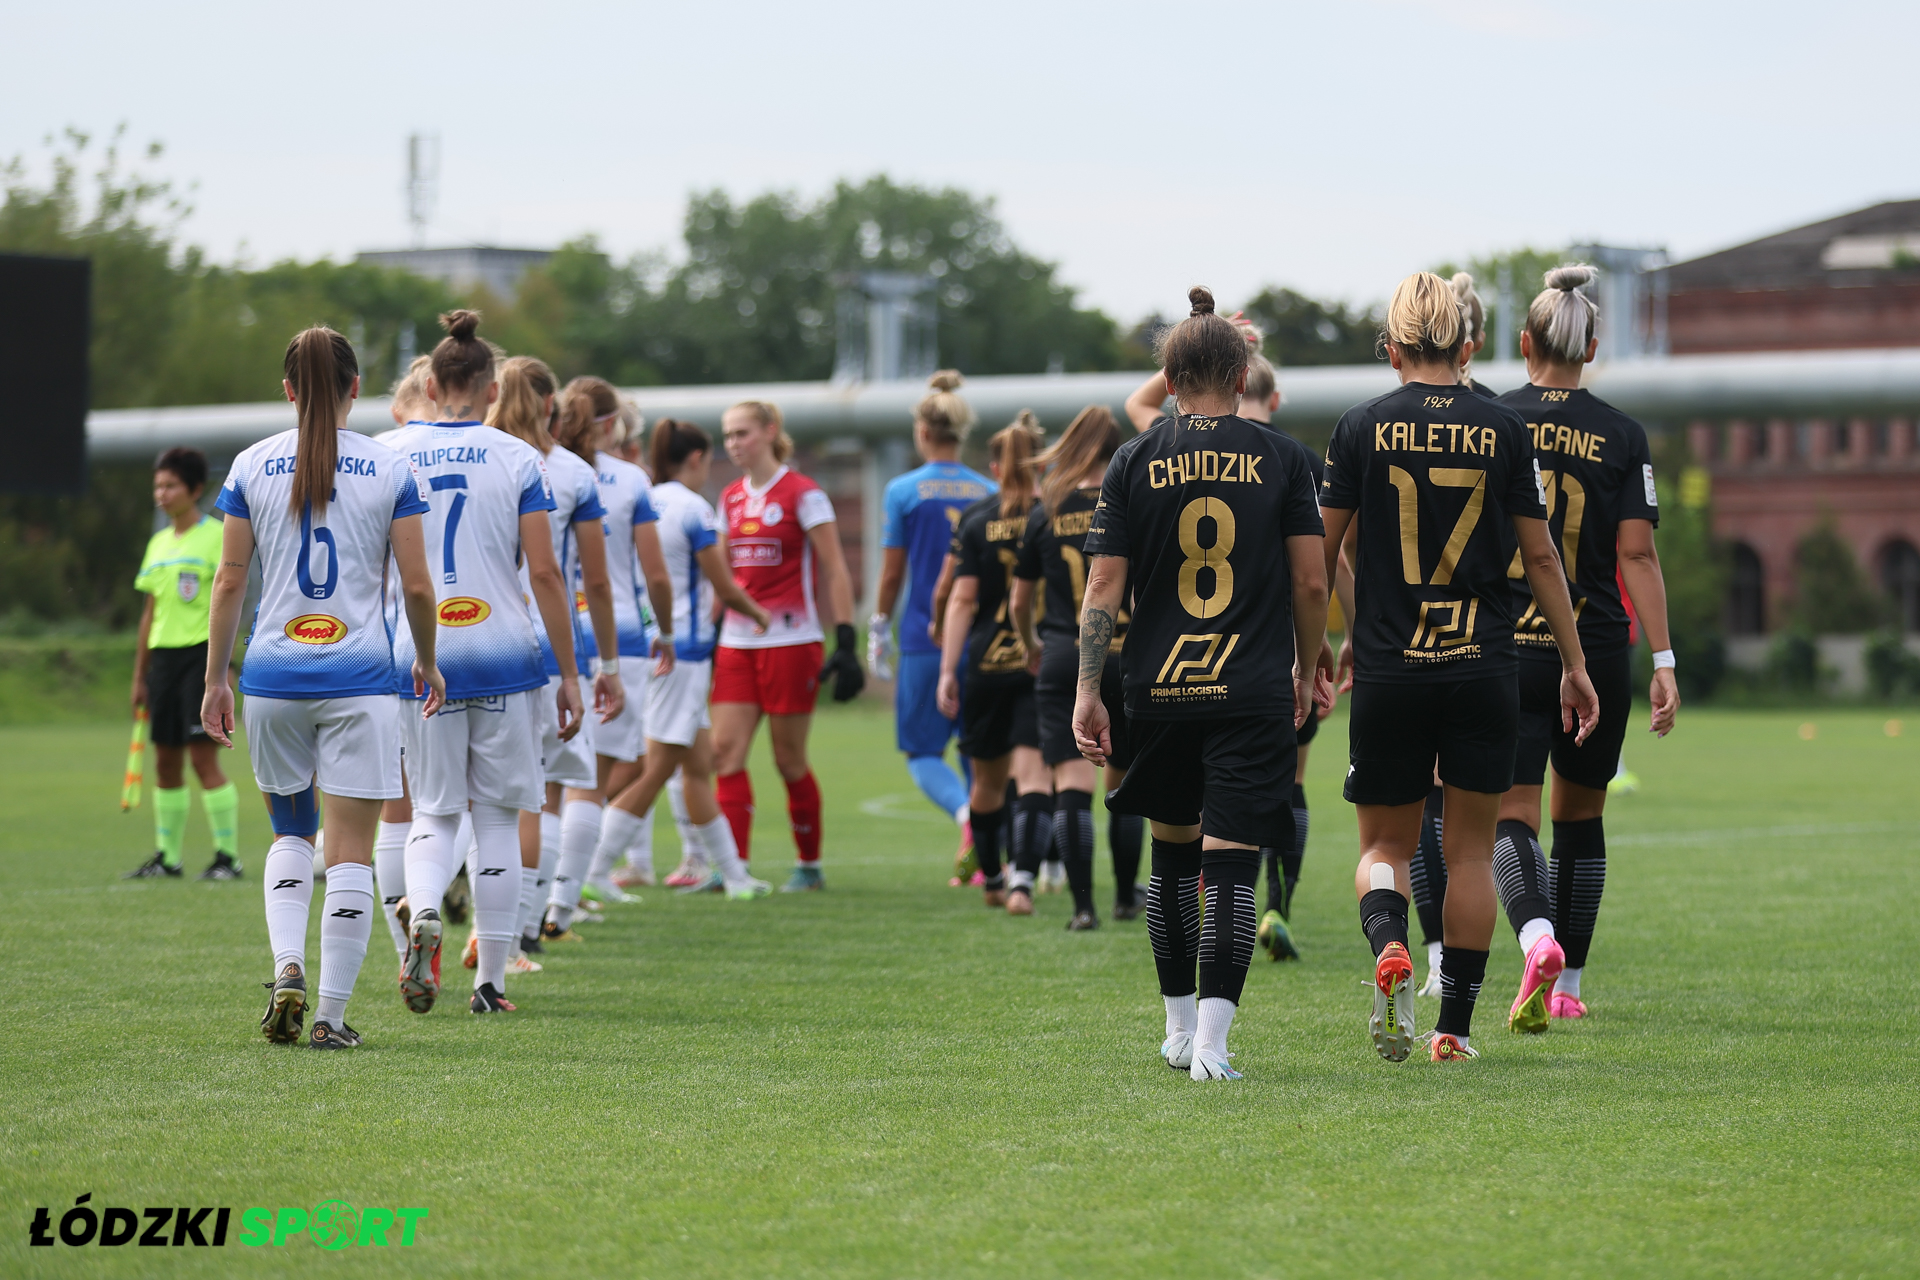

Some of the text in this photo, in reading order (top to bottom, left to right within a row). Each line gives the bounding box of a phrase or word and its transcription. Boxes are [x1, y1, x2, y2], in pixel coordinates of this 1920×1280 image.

[1424, 396, 1454, 408] 1924
[1541, 391, 1571, 402] 1924
[1188, 419, 1218, 431] 1924
[1375, 421, 1497, 458] KALETKA
[410, 446, 488, 467] FILIPCZAK
[1149, 450, 1263, 490] CHUDZIK
[428, 473, 469, 586] 7
[1388, 464, 1487, 586] 17
[296, 489, 340, 601] 6
[1177, 496, 1236, 620] 8
[1403, 644, 1481, 659] PRIME LOGISTIC
[1151, 685, 1228, 697] PRIME LOGISTIC
